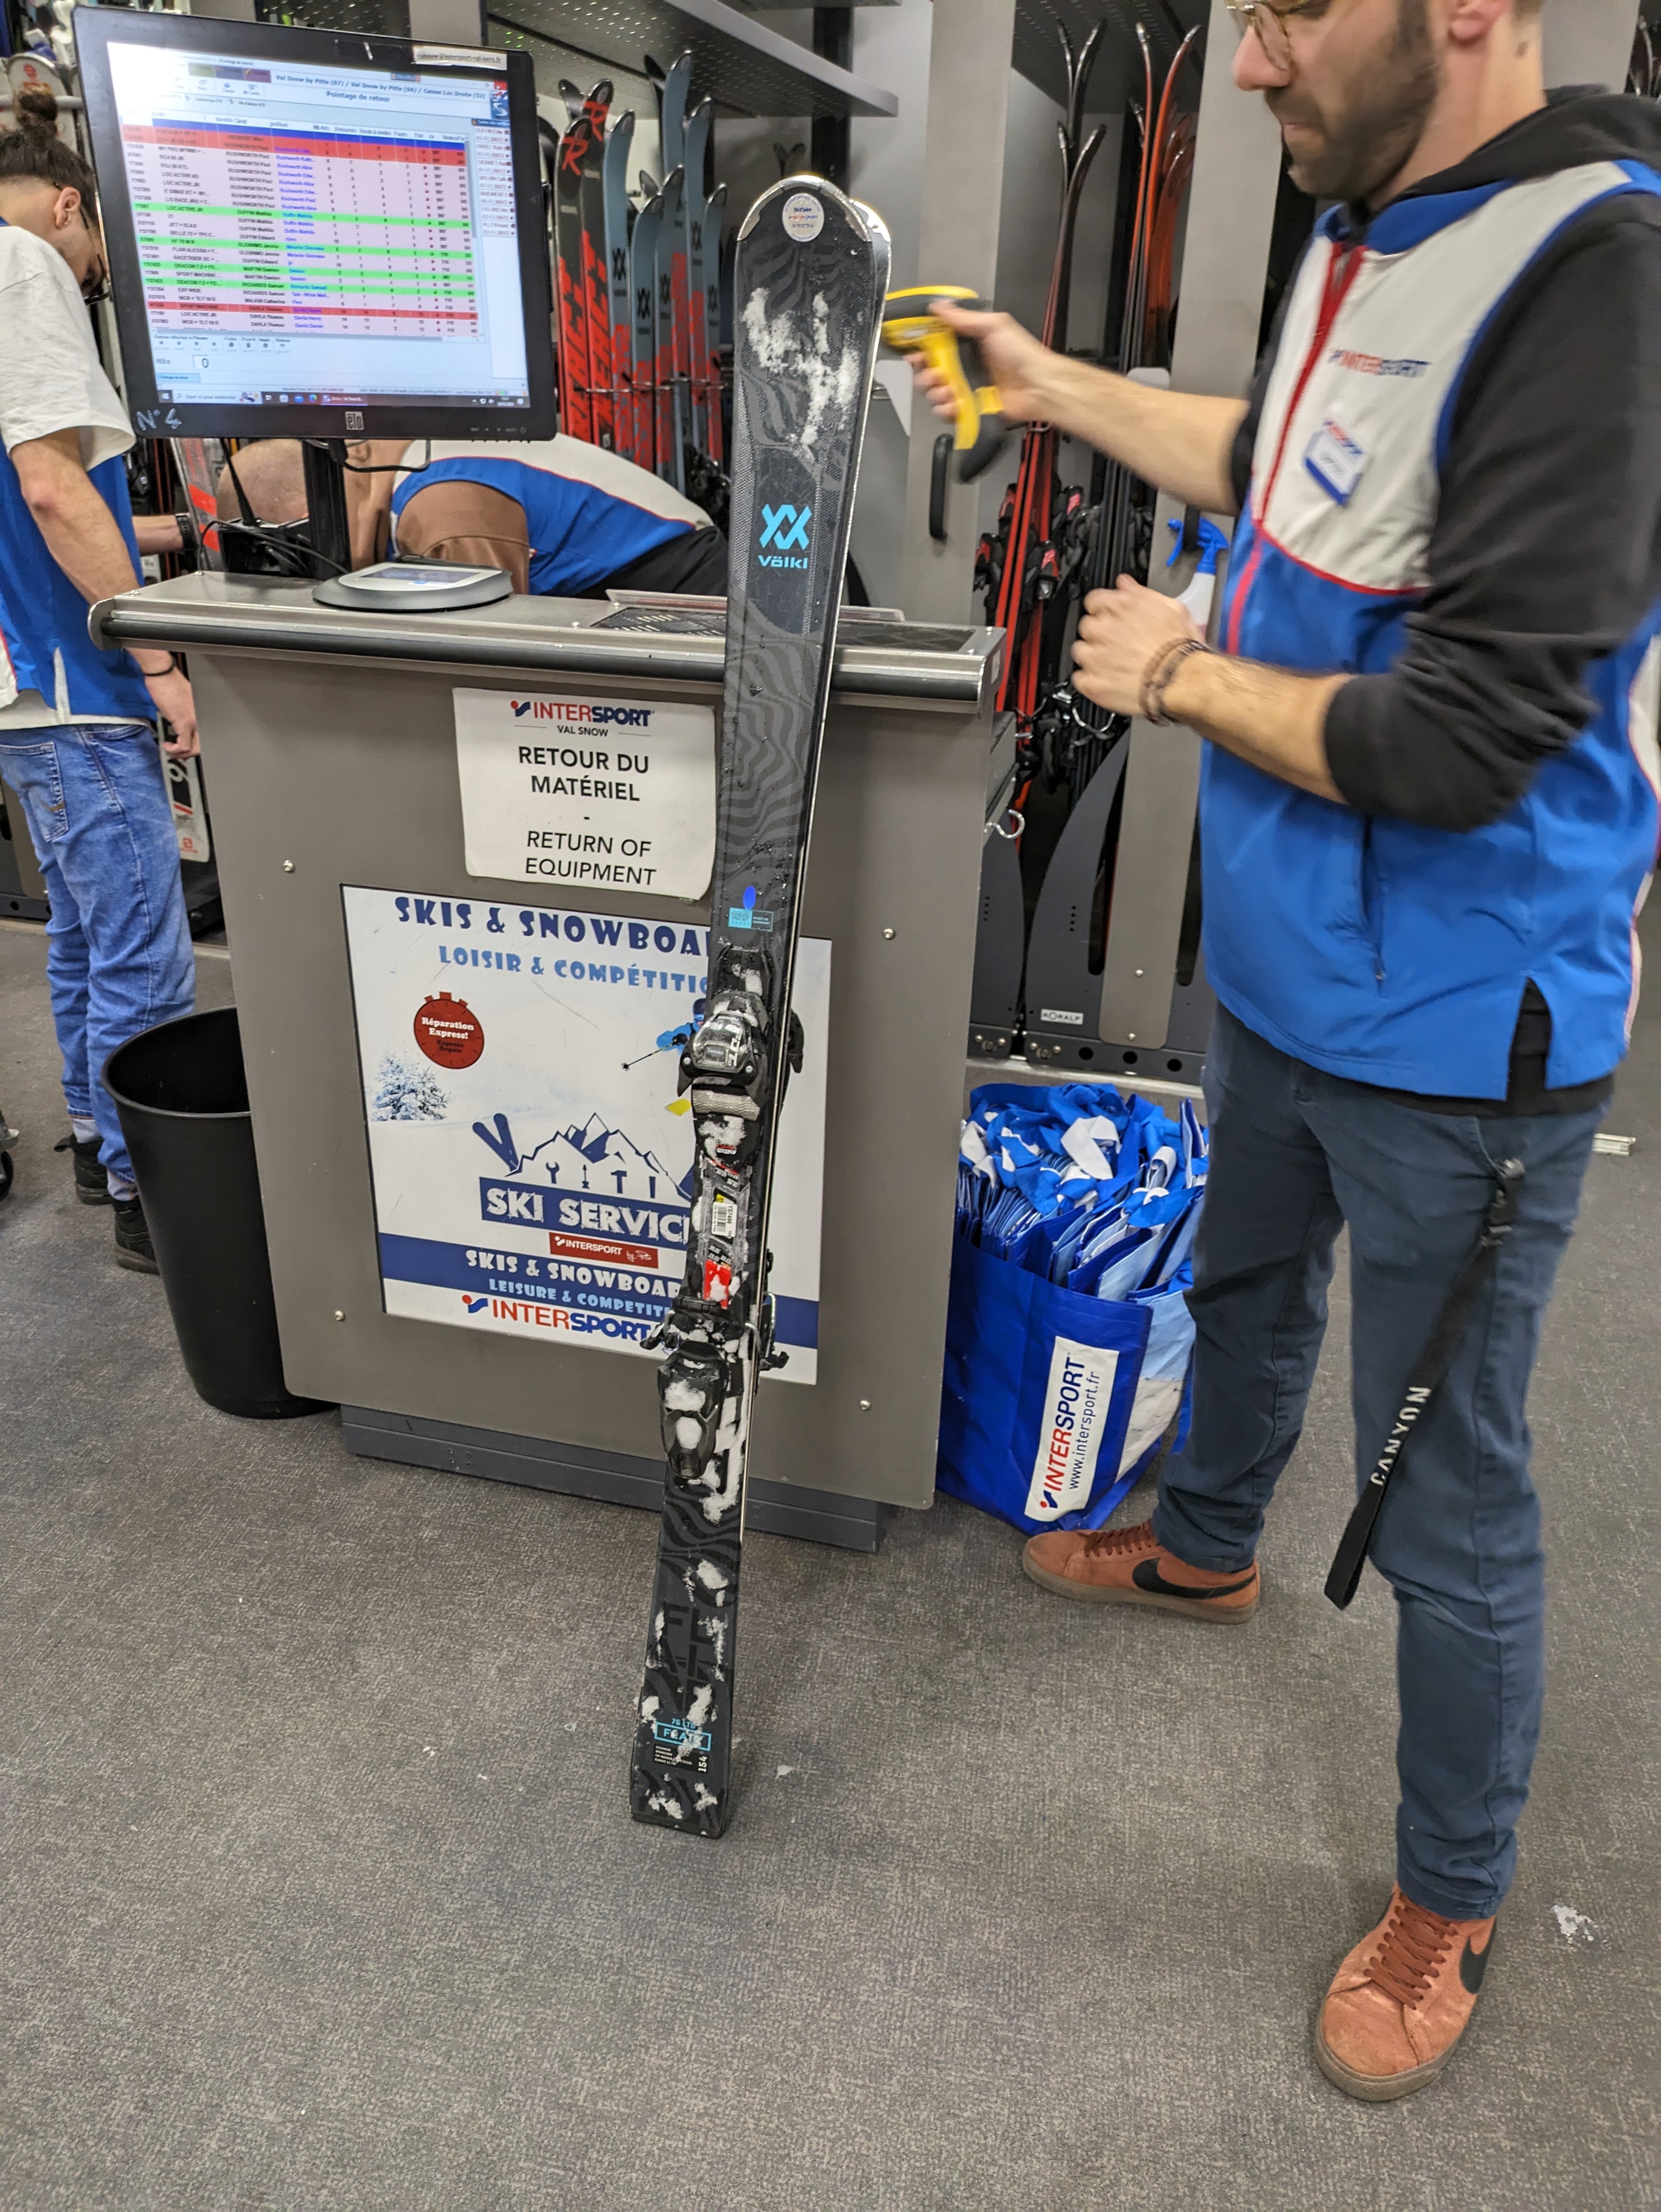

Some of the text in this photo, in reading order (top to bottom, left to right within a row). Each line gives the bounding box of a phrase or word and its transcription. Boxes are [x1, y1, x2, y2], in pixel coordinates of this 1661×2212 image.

[201, 358, 210, 368] 0
[758, 554, 808, 569] Völkl
[534, 702, 651, 727] INTERSPORT
[557, 725, 609, 737] VAL SNOW
[519, 746, 649, 774] RETOUR DU
[531, 775, 640, 802] MATÉRIEL
[527, 830, 652, 857] RETURN OF
[526, 857, 657, 885] EQUIPMENT
[395, 896, 472, 929] SKIS
[487, 907, 505, 933] &
[439, 945, 521, 973] LOISIR
[531, 956, 544, 975] &
[421, 1017, 475, 1031] Réparation
[429, 1028, 469, 1040] Express!
[486, 1188, 544, 1223] SKI
[565, 1239, 622, 1256] INTERSPORT
[465, 1250, 517, 1273] SKIS
[527, 1259, 541, 1277] &
[489, 1279, 557, 1302] LEISURE
[563, 1290, 572, 1304] &
[493, 1299, 651, 1341] INTERSPORT
[1043, 1357, 1085, 1492] INTERSPORT
[1068, 1371, 1101, 1490] www.intersport.fr
[1371, 1385, 1432, 1486] CANYON
[698, 1756, 708, 1773] 154
